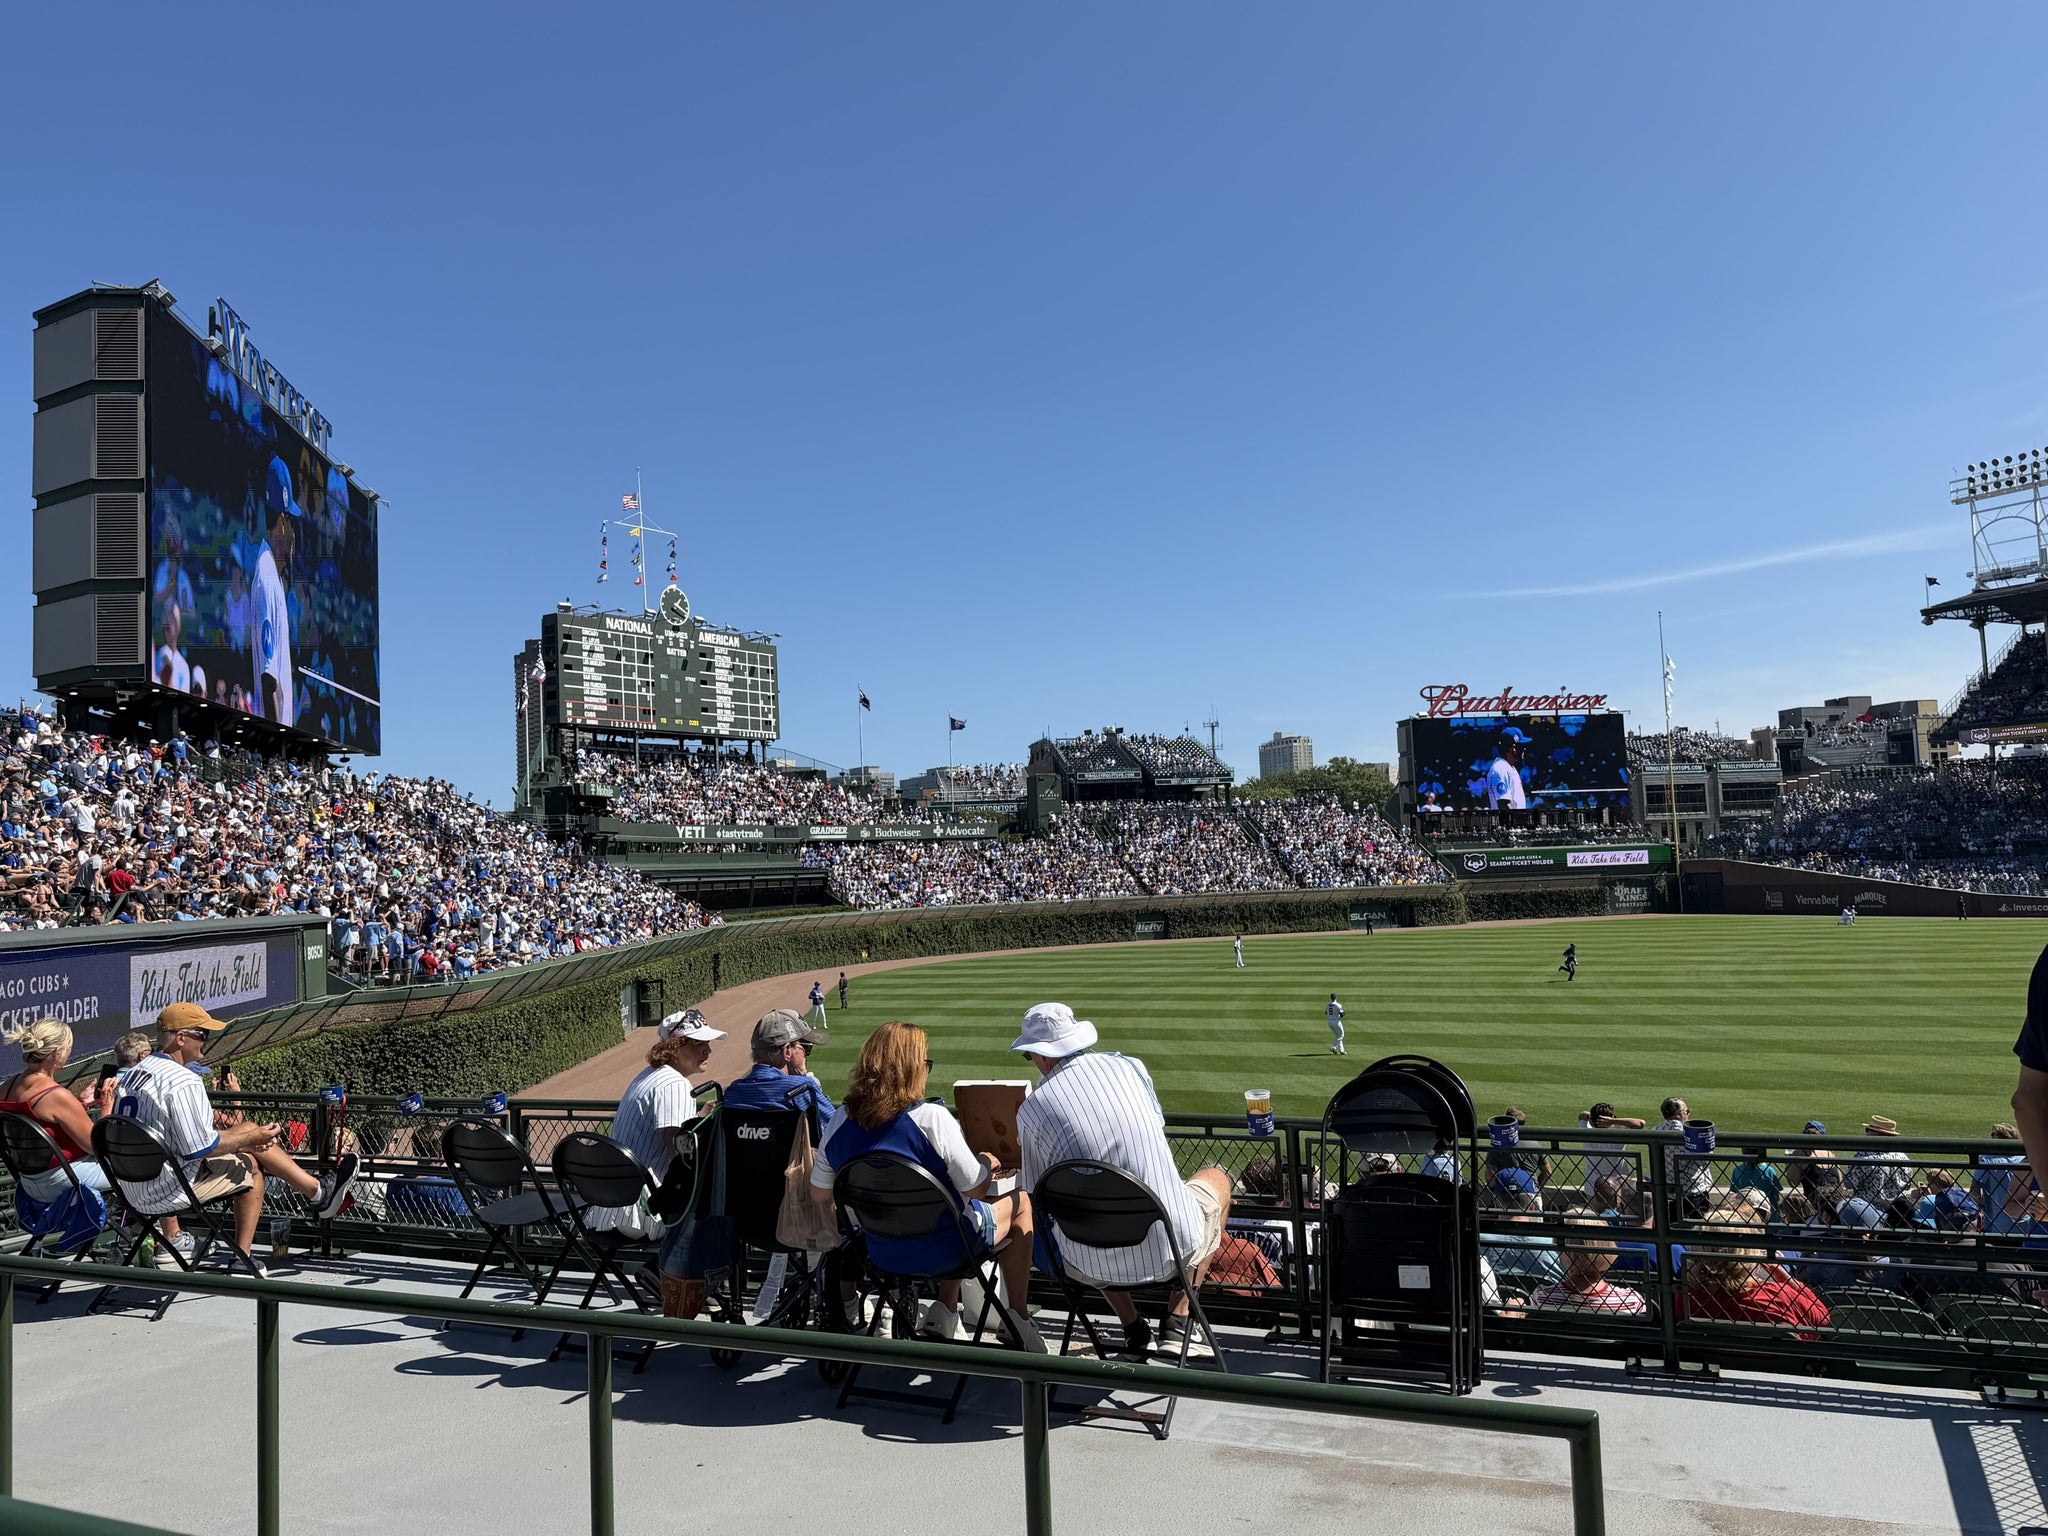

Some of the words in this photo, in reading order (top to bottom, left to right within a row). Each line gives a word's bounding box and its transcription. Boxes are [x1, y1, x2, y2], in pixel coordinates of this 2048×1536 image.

[606, 617, 654, 635] NATIONAL
[699, 631, 740, 649] AMERICAN
[1420, 684, 1608, 719] Budweiser
[676, 825, 705, 839] YETI
[722, 828, 764, 839] tastytrade
[809, 826, 848, 835] GRAINGER
[945, 826, 986, 836] Advocate
[1572, 855, 1588, 864] Kids
[1590, 853, 1608, 864] Take
[1609, 853, 1620, 863] the
[1623, 852, 1645, 862] Field
[1614, 887, 1648, 897] DRAFT
[1619, 893, 1648, 902] KINGS
[1854, 891, 1887, 905] MARQUEE
[1795, 894, 1821, 905] Vienna
[1821, 894, 1840, 907] Beef
[2013, 903, 2048, 912] Invesco
[1138, 922, 1162, 931] Hefty
[307, 945, 324, 960] BOSCH
[30, 974, 60, 994] CUBS
[139, 969, 172, 1013] Kids
[176, 961, 208, 1003] Take
[209, 960, 228, 999] the
[230, 952, 262, 993] Field
[44, 995, 99, 1024] HOLDER
[737, 1123, 771, 1140] drive
